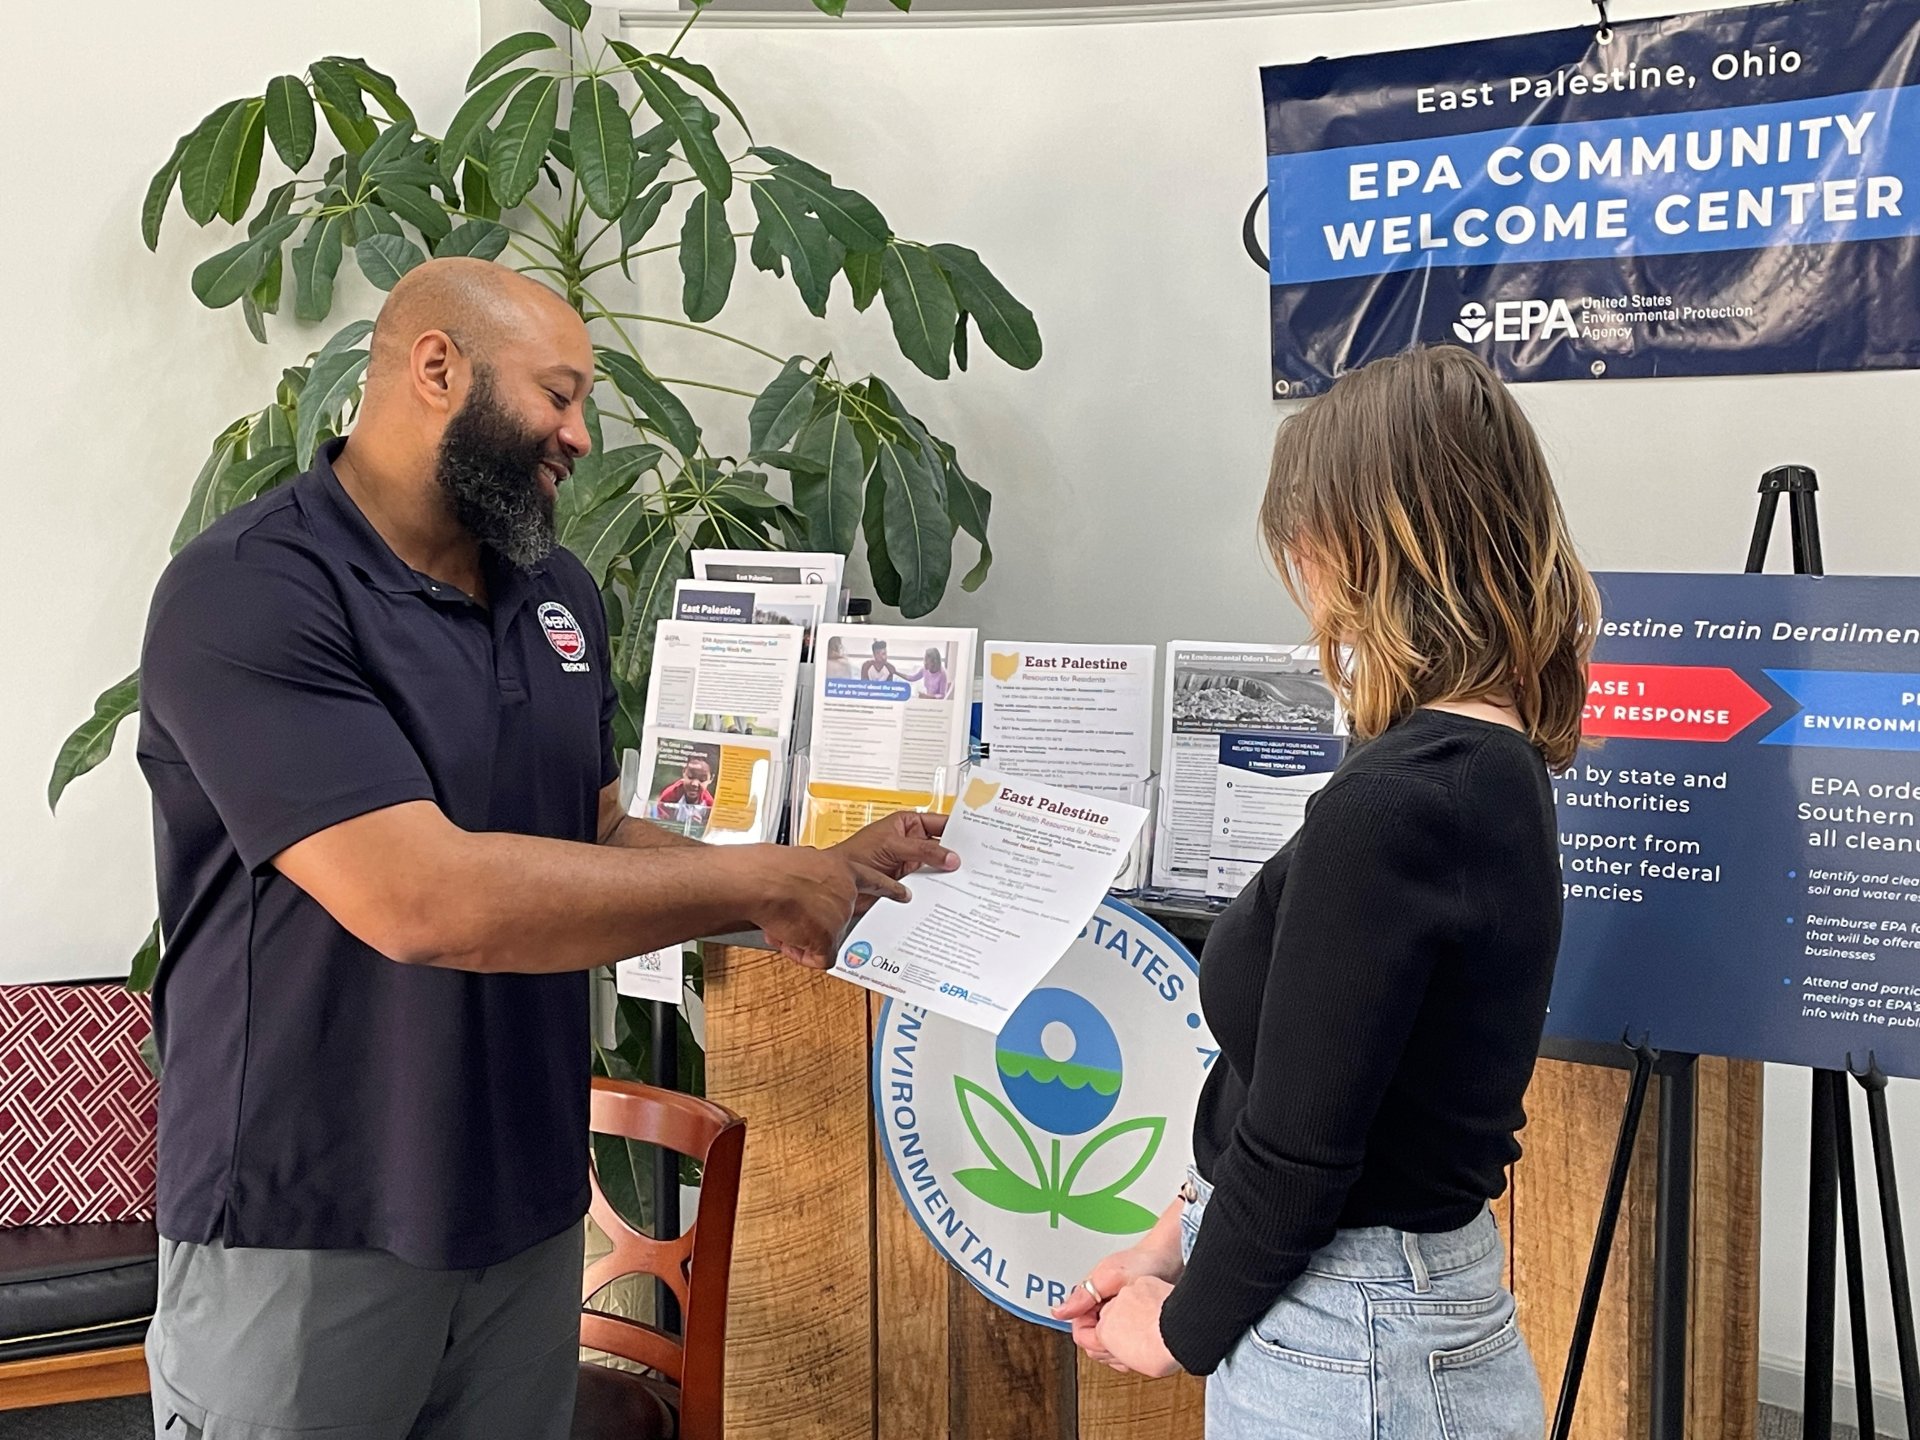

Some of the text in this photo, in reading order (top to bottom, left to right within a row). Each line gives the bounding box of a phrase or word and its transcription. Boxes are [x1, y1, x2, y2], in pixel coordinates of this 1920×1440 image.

[1416, 45, 1803, 114] East Palestine, Ohio
[1348, 111, 1876, 201] EPA COMMUNITY
[1323, 175, 1904, 261] WELCOME CENTER
[1582, 294, 1672, 310] United States
[1495, 298, 1580, 341] EPA
[1582, 304, 1754, 325] Environmental Protection
[1582, 325, 1633, 340] Agency
[682, 604, 741, 615] East Palestine
[1579, 617, 1920, 644] lestine Train Derailmen
[1025, 656, 1128, 670] East Palestine
[1072, 675, 1105, 683] Residents
[1637, 682, 1645, 696] 1
[1614, 706, 1729, 724] RESPONSE
[1804, 715, 1920, 733] ENVIRONM
[1586, 765, 1612, 786] by
[1619, 769, 1676, 786] state
[1683, 772, 1727, 788] and
[1811, 777, 1860, 797] EPA
[1000, 788, 1109, 825] East Palestine
[1566, 791, 1690, 813] authorities
[1798, 802, 1914, 826] Southern
[993, 806, 1120, 843] Mental Health Resources for Residents
[1560, 832, 1700, 854] upport from
[1809, 829, 1836, 847] all
[1572, 857, 1632, 875] other
[1640, 860, 1721, 882] federal
[1809, 869, 1859, 884] Identify
[1862, 874, 1889, 884] and
[1808, 885, 1831, 895] soil
[1833, 888, 1860, 897] and
[1862, 890, 1901, 900] water
[1807, 915, 1877, 930] Reimburse
[1880, 921, 1907, 932] EPA
[1806, 930, 1834, 942] that
[1837, 933, 1860, 944] will
[1863, 935, 1880, 945] be
[1805, 945, 1876, 961] businesses
[871, 955, 900, 974] Ohio
[949, 985, 969, 1000] EPA
[1803, 976, 1849, 989] Attend
[1851, 982, 1878, 992] and
[1803, 993, 1864, 1008] meetings
[1868, 999, 1882, 1008] at
[1802, 1006, 1827, 1018] info
[1830, 1010, 1859, 1021] with
[1863, 1013, 1885, 1024] the
[1025, 1273, 1080, 1306] PR
